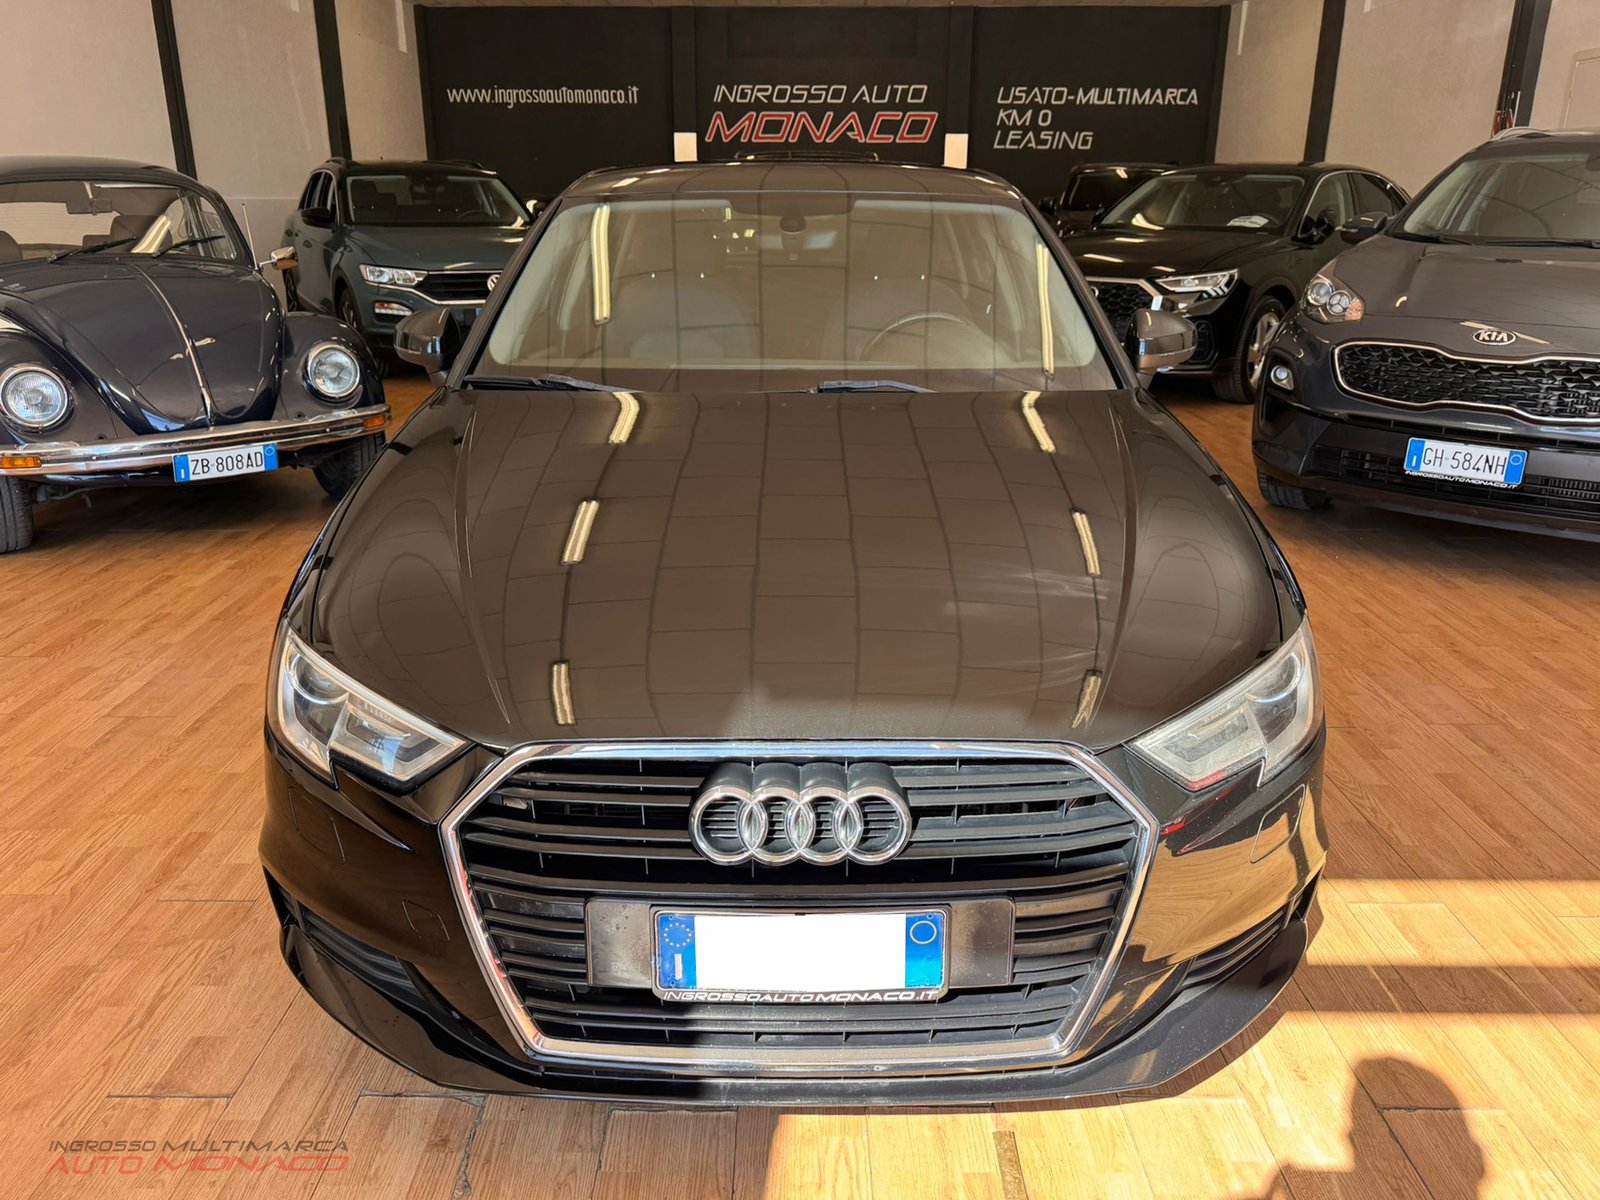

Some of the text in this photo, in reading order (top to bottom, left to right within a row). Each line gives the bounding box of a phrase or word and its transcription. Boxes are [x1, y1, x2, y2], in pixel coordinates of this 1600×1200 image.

[447, 85, 639, 108] www.ingrossoautomonaco.it
[713, 84, 928, 103] INGROSSO AUTO
[997, 87, 1199, 105] USATO-MULTIMARCA
[705, 111, 939, 143] MONACO
[996, 109, 1032, 126] KM
[993, 130, 1094, 149] LEASING
[1478, 331, 1508, 342] KIA
